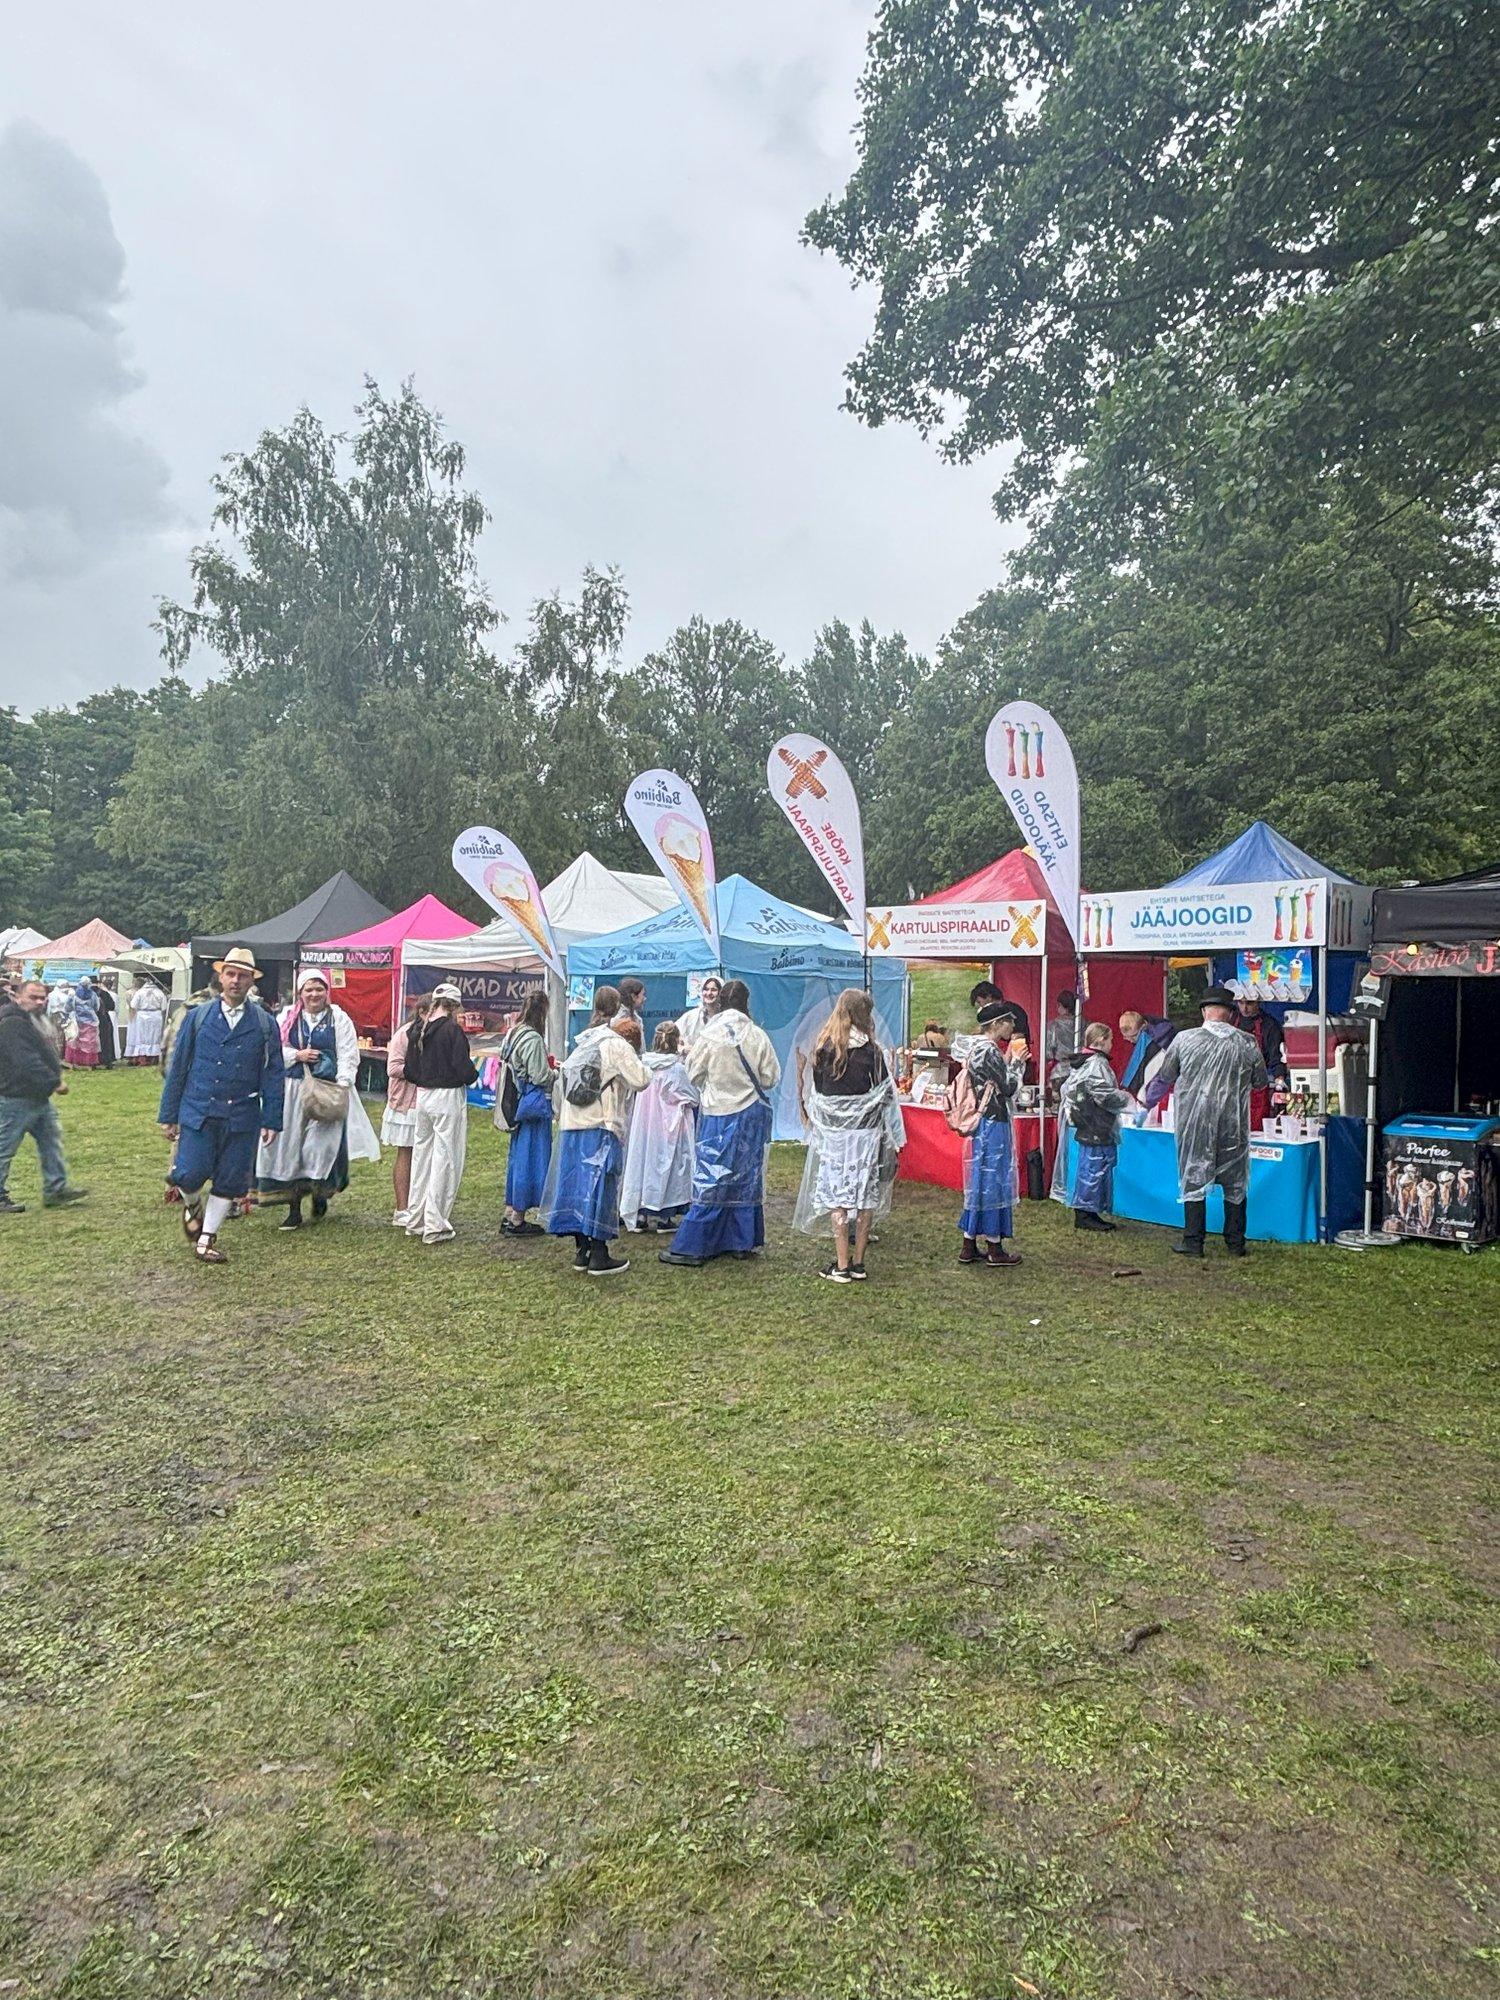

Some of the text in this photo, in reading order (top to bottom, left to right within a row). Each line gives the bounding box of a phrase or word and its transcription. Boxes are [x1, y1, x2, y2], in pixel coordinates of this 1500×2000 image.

[1130, 905, 1253, 928] JÄÄJOOGID
[746, 918, 826, 935] Balbiino
[890, 919, 1011, 935] KARTULISPIRAALID
[770, 954, 804, 971] Balbiino
[1476, 945, 1500, 974] J
[1406, 1142, 1451, 1157] Parfee
